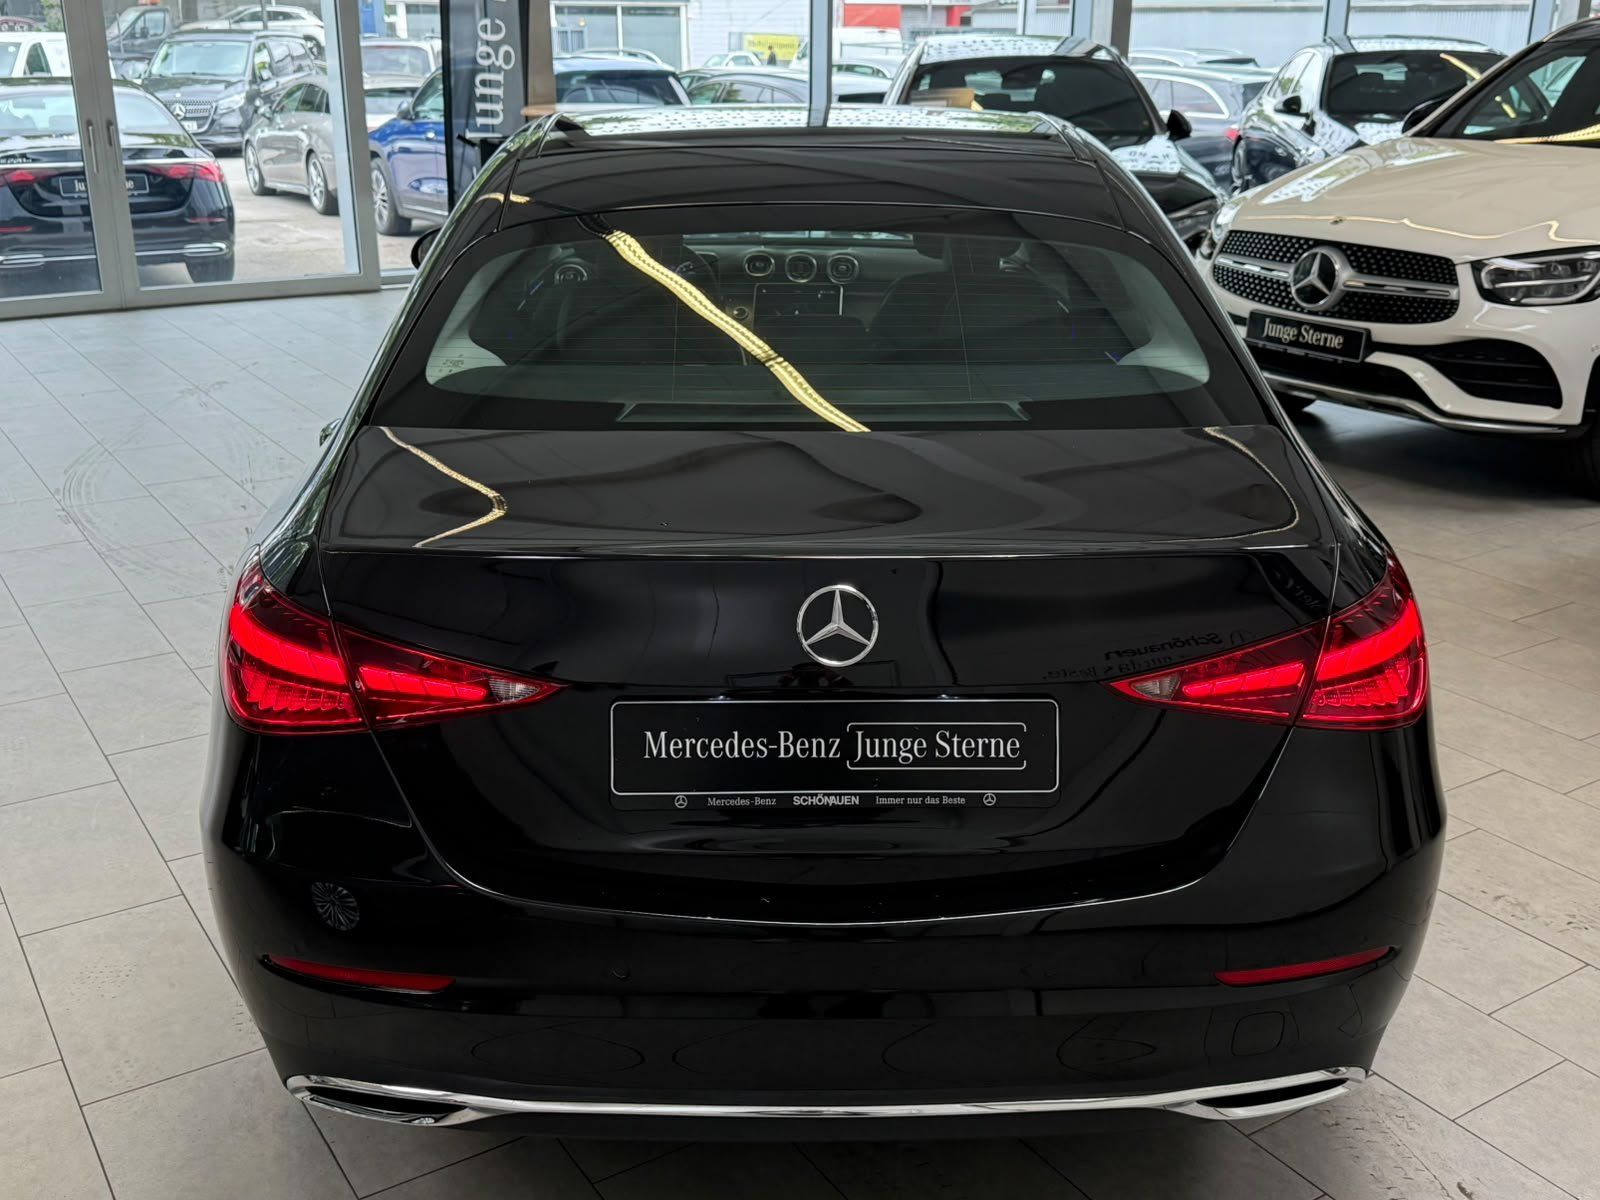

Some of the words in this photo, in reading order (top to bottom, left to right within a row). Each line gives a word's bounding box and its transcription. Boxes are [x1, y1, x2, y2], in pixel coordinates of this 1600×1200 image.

[1262, 318, 1298, 344] Junge
[1299, 324, 1345, 350] Sterne
[643, 730, 841, 759] Mercedes-Benz
[853, 730, 928, 765] Junge
[935, 730, 1020, 759] Sterne
[707, 796, 777, 807] Mercedes-Benz
[875, 795, 905, 805] Immer
[906, 796, 923, 805] nur
[924, 795, 940, 805] das
[942, 795, 966, 805] Beste
